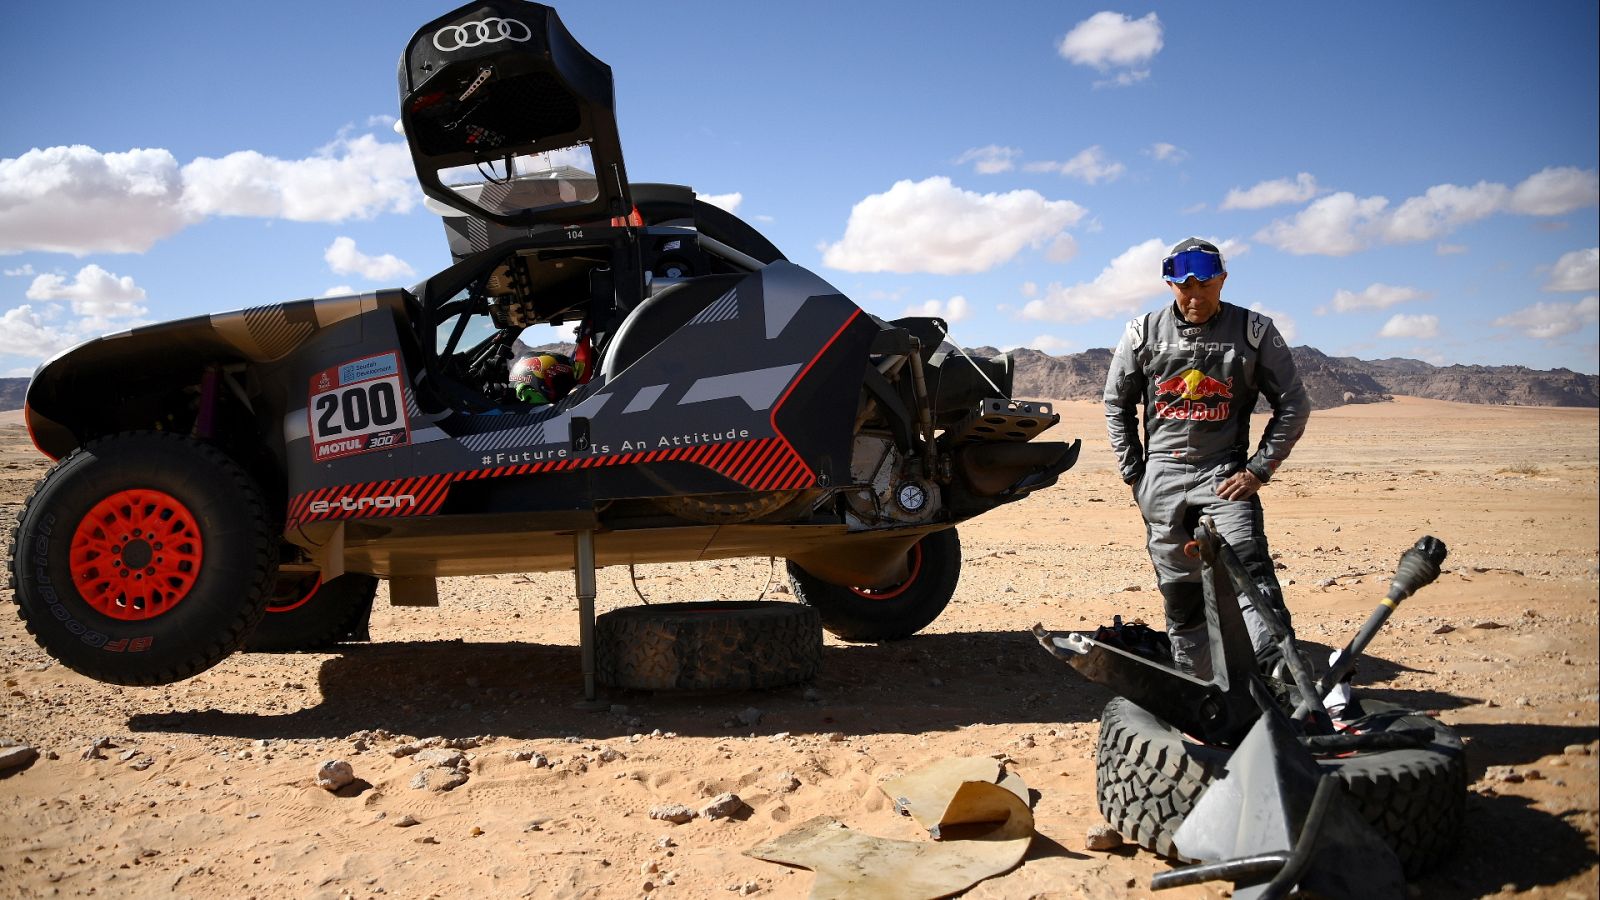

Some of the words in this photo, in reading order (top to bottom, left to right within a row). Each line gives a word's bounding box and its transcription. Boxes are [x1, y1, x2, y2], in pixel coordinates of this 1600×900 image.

[566, 230, 584, 239] 104
[1154, 339, 1235, 351] e-tron
[316, 382, 397, 437] 200
[1155, 400, 1190, 419] Red
[1191, 402, 1229, 421] Bull
[318, 438, 362, 456] MOTUL
[481, 447, 567, 466] #Future
[590, 443, 610, 455] Is
[621, 440, 647, 451] An
[657, 428, 750, 448] Attitude
[309, 494, 415, 513] e-tron
